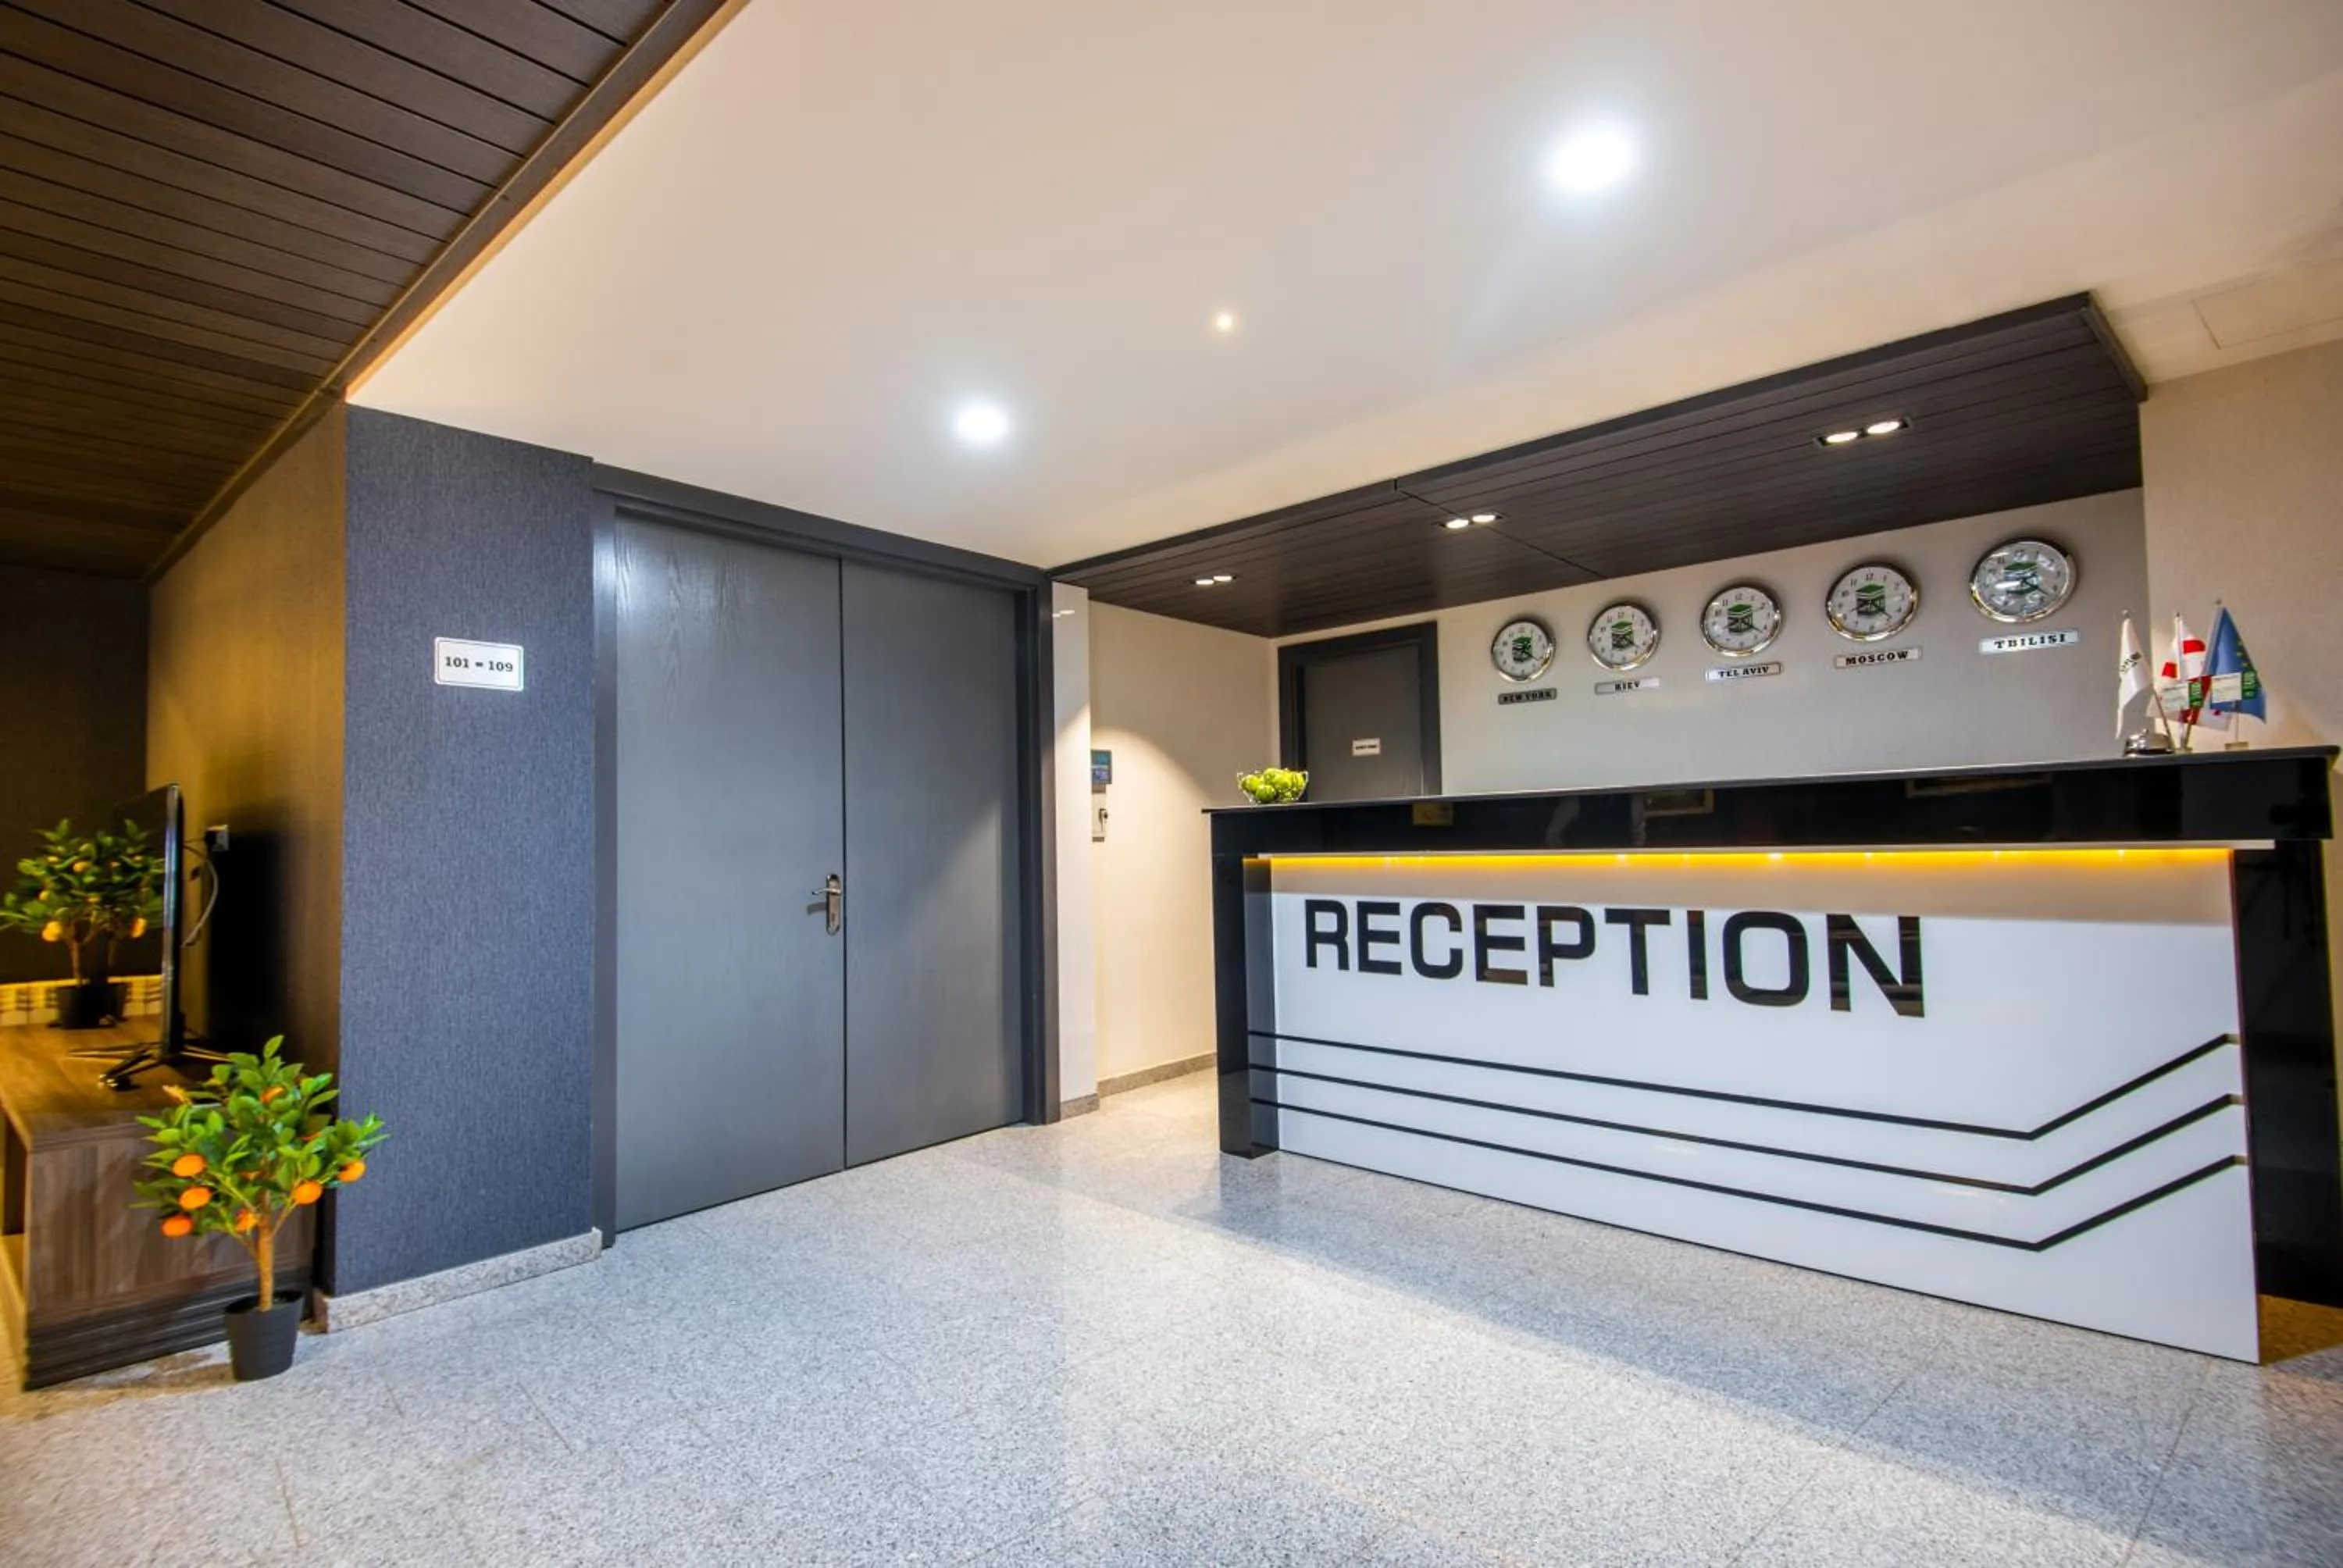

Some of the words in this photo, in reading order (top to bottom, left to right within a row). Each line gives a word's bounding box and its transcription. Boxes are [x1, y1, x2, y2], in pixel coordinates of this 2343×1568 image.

[1994, 633, 2066, 649] TBILISI
[444, 656, 469, 669] 101
[488, 660, 513, 672] 109
[1846, 650, 1908, 666] MOSCOW
[1718, 669, 1739, 679] TEL
[1742, 666, 1769, 675] AVIV
[1305, 899, 1925, 1018] RECEPTION
